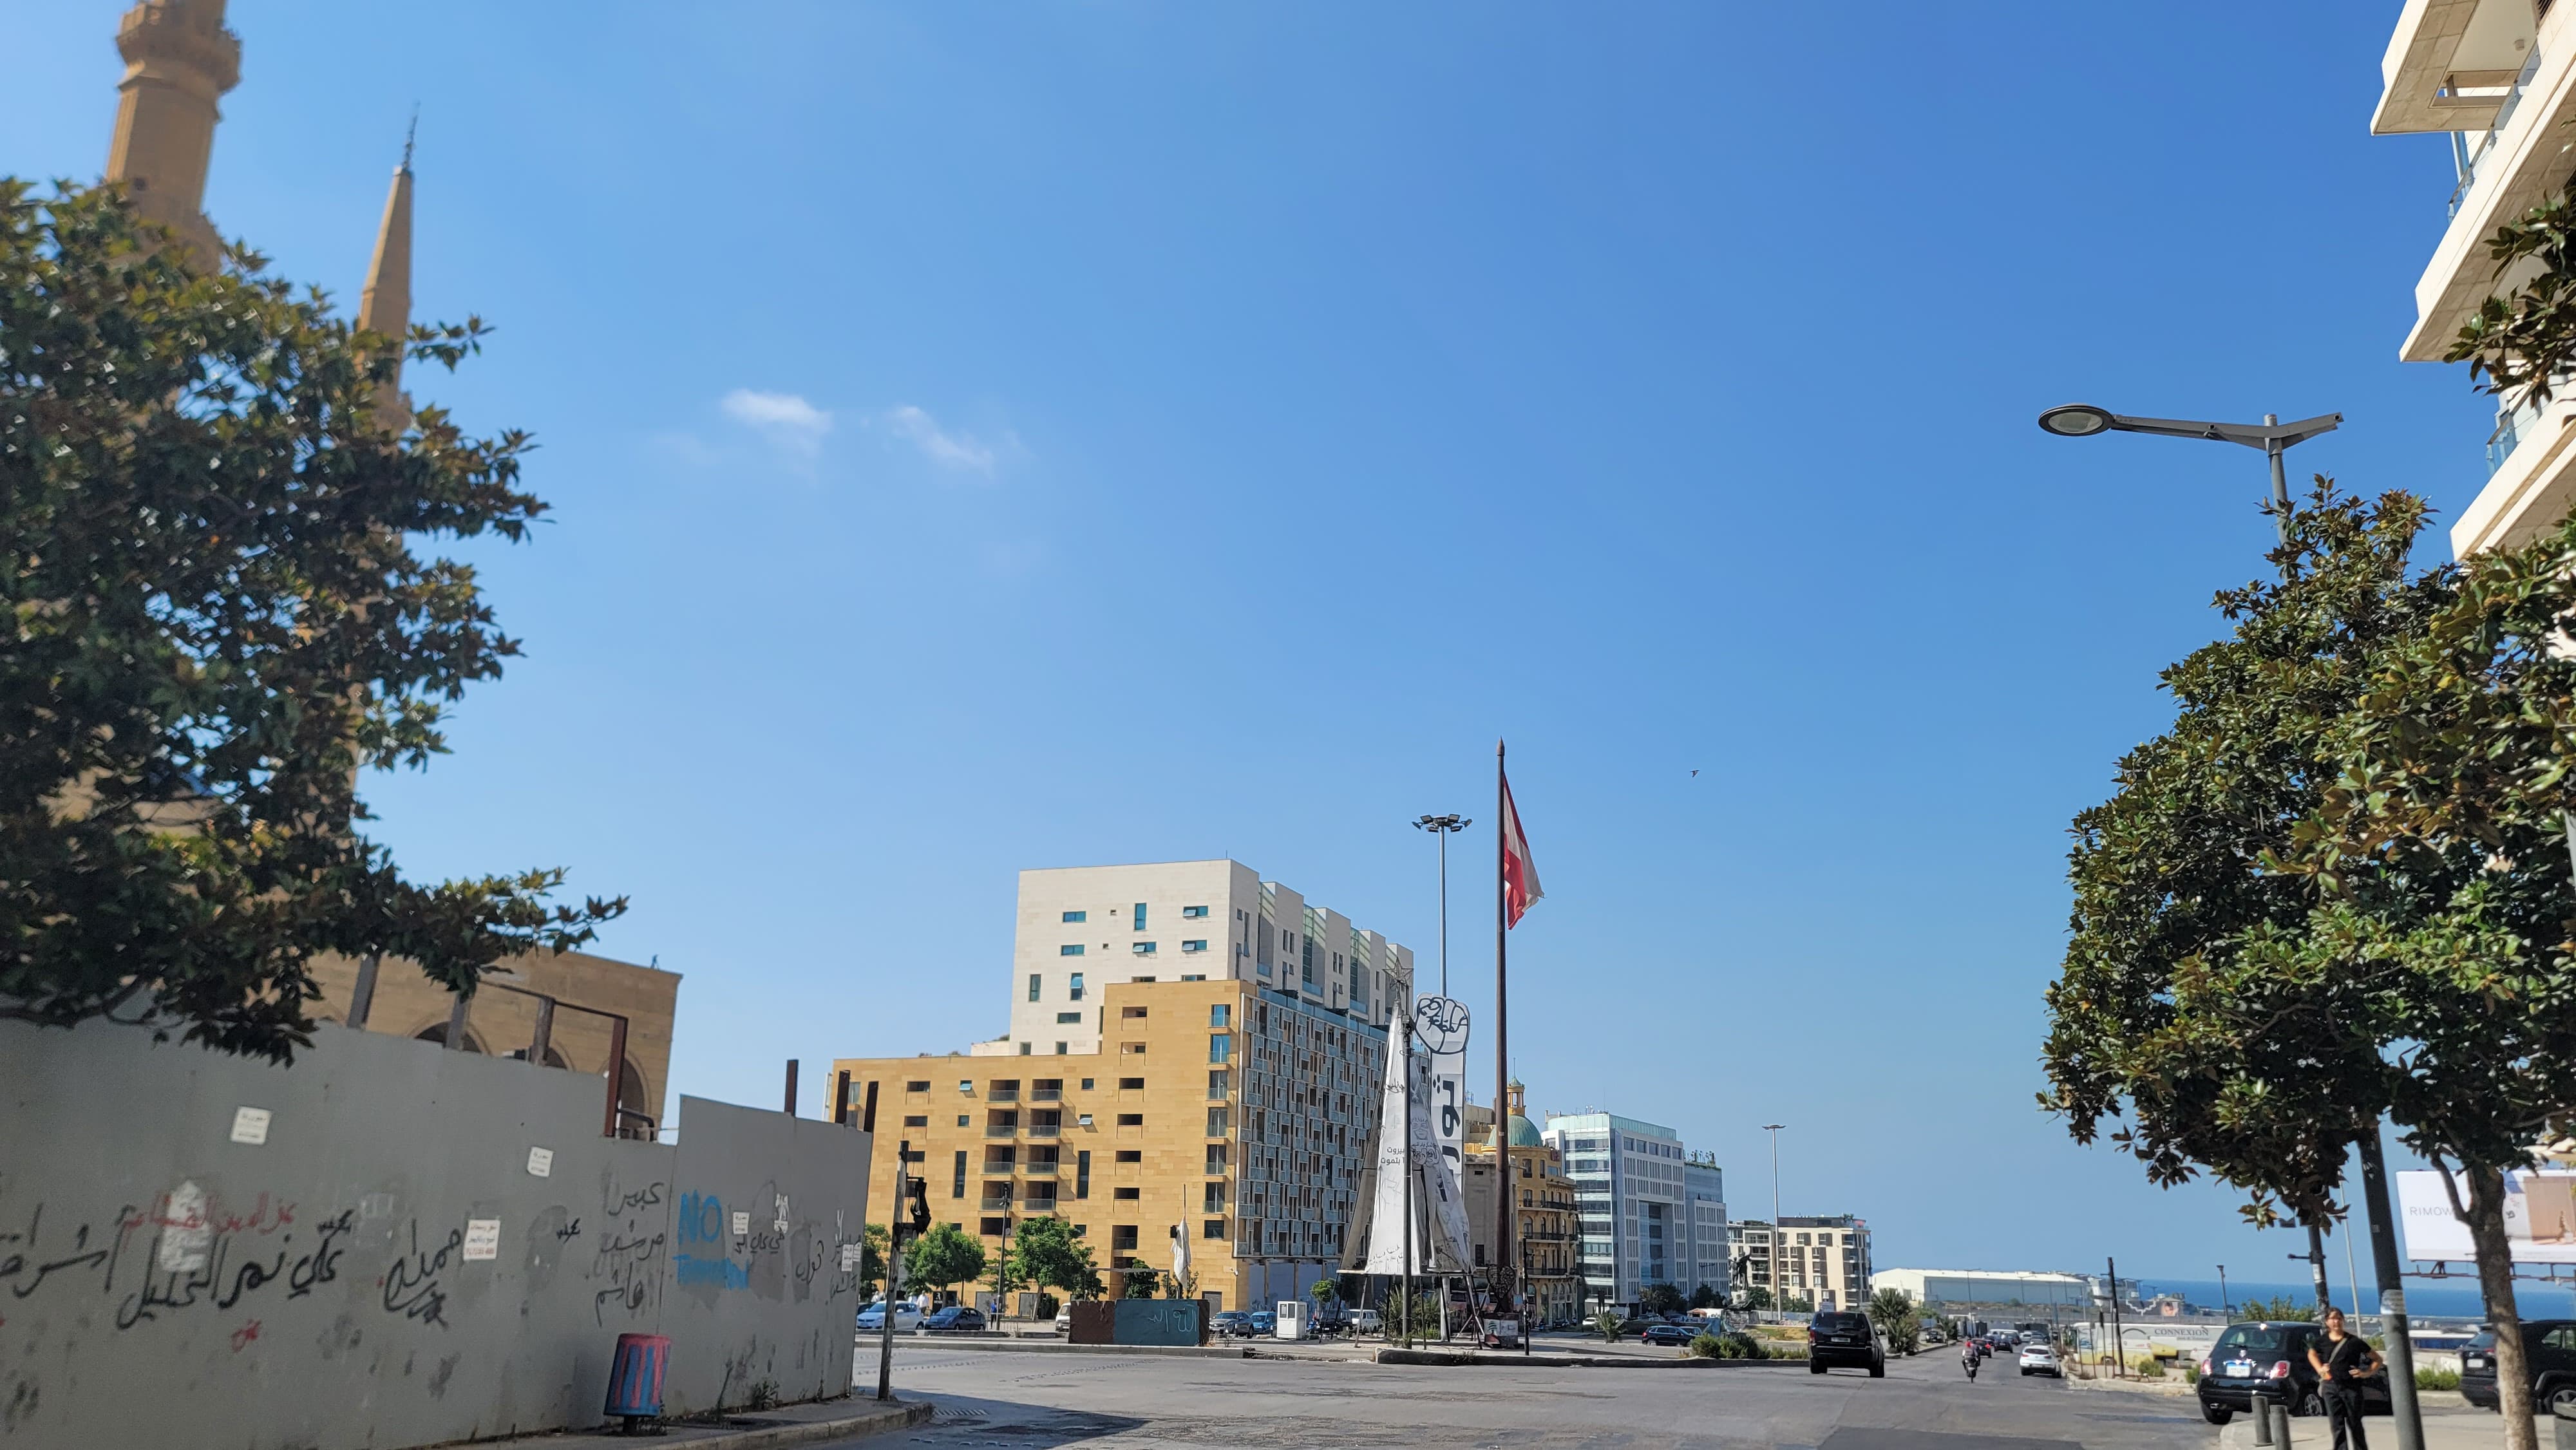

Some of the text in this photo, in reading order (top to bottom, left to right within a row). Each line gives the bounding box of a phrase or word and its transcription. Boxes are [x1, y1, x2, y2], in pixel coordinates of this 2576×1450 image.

[1432, 1073, 1461, 1178] ثور
[678, 1189, 723, 1245] NO
[2410, 1207, 2453, 1216] RIMOW
